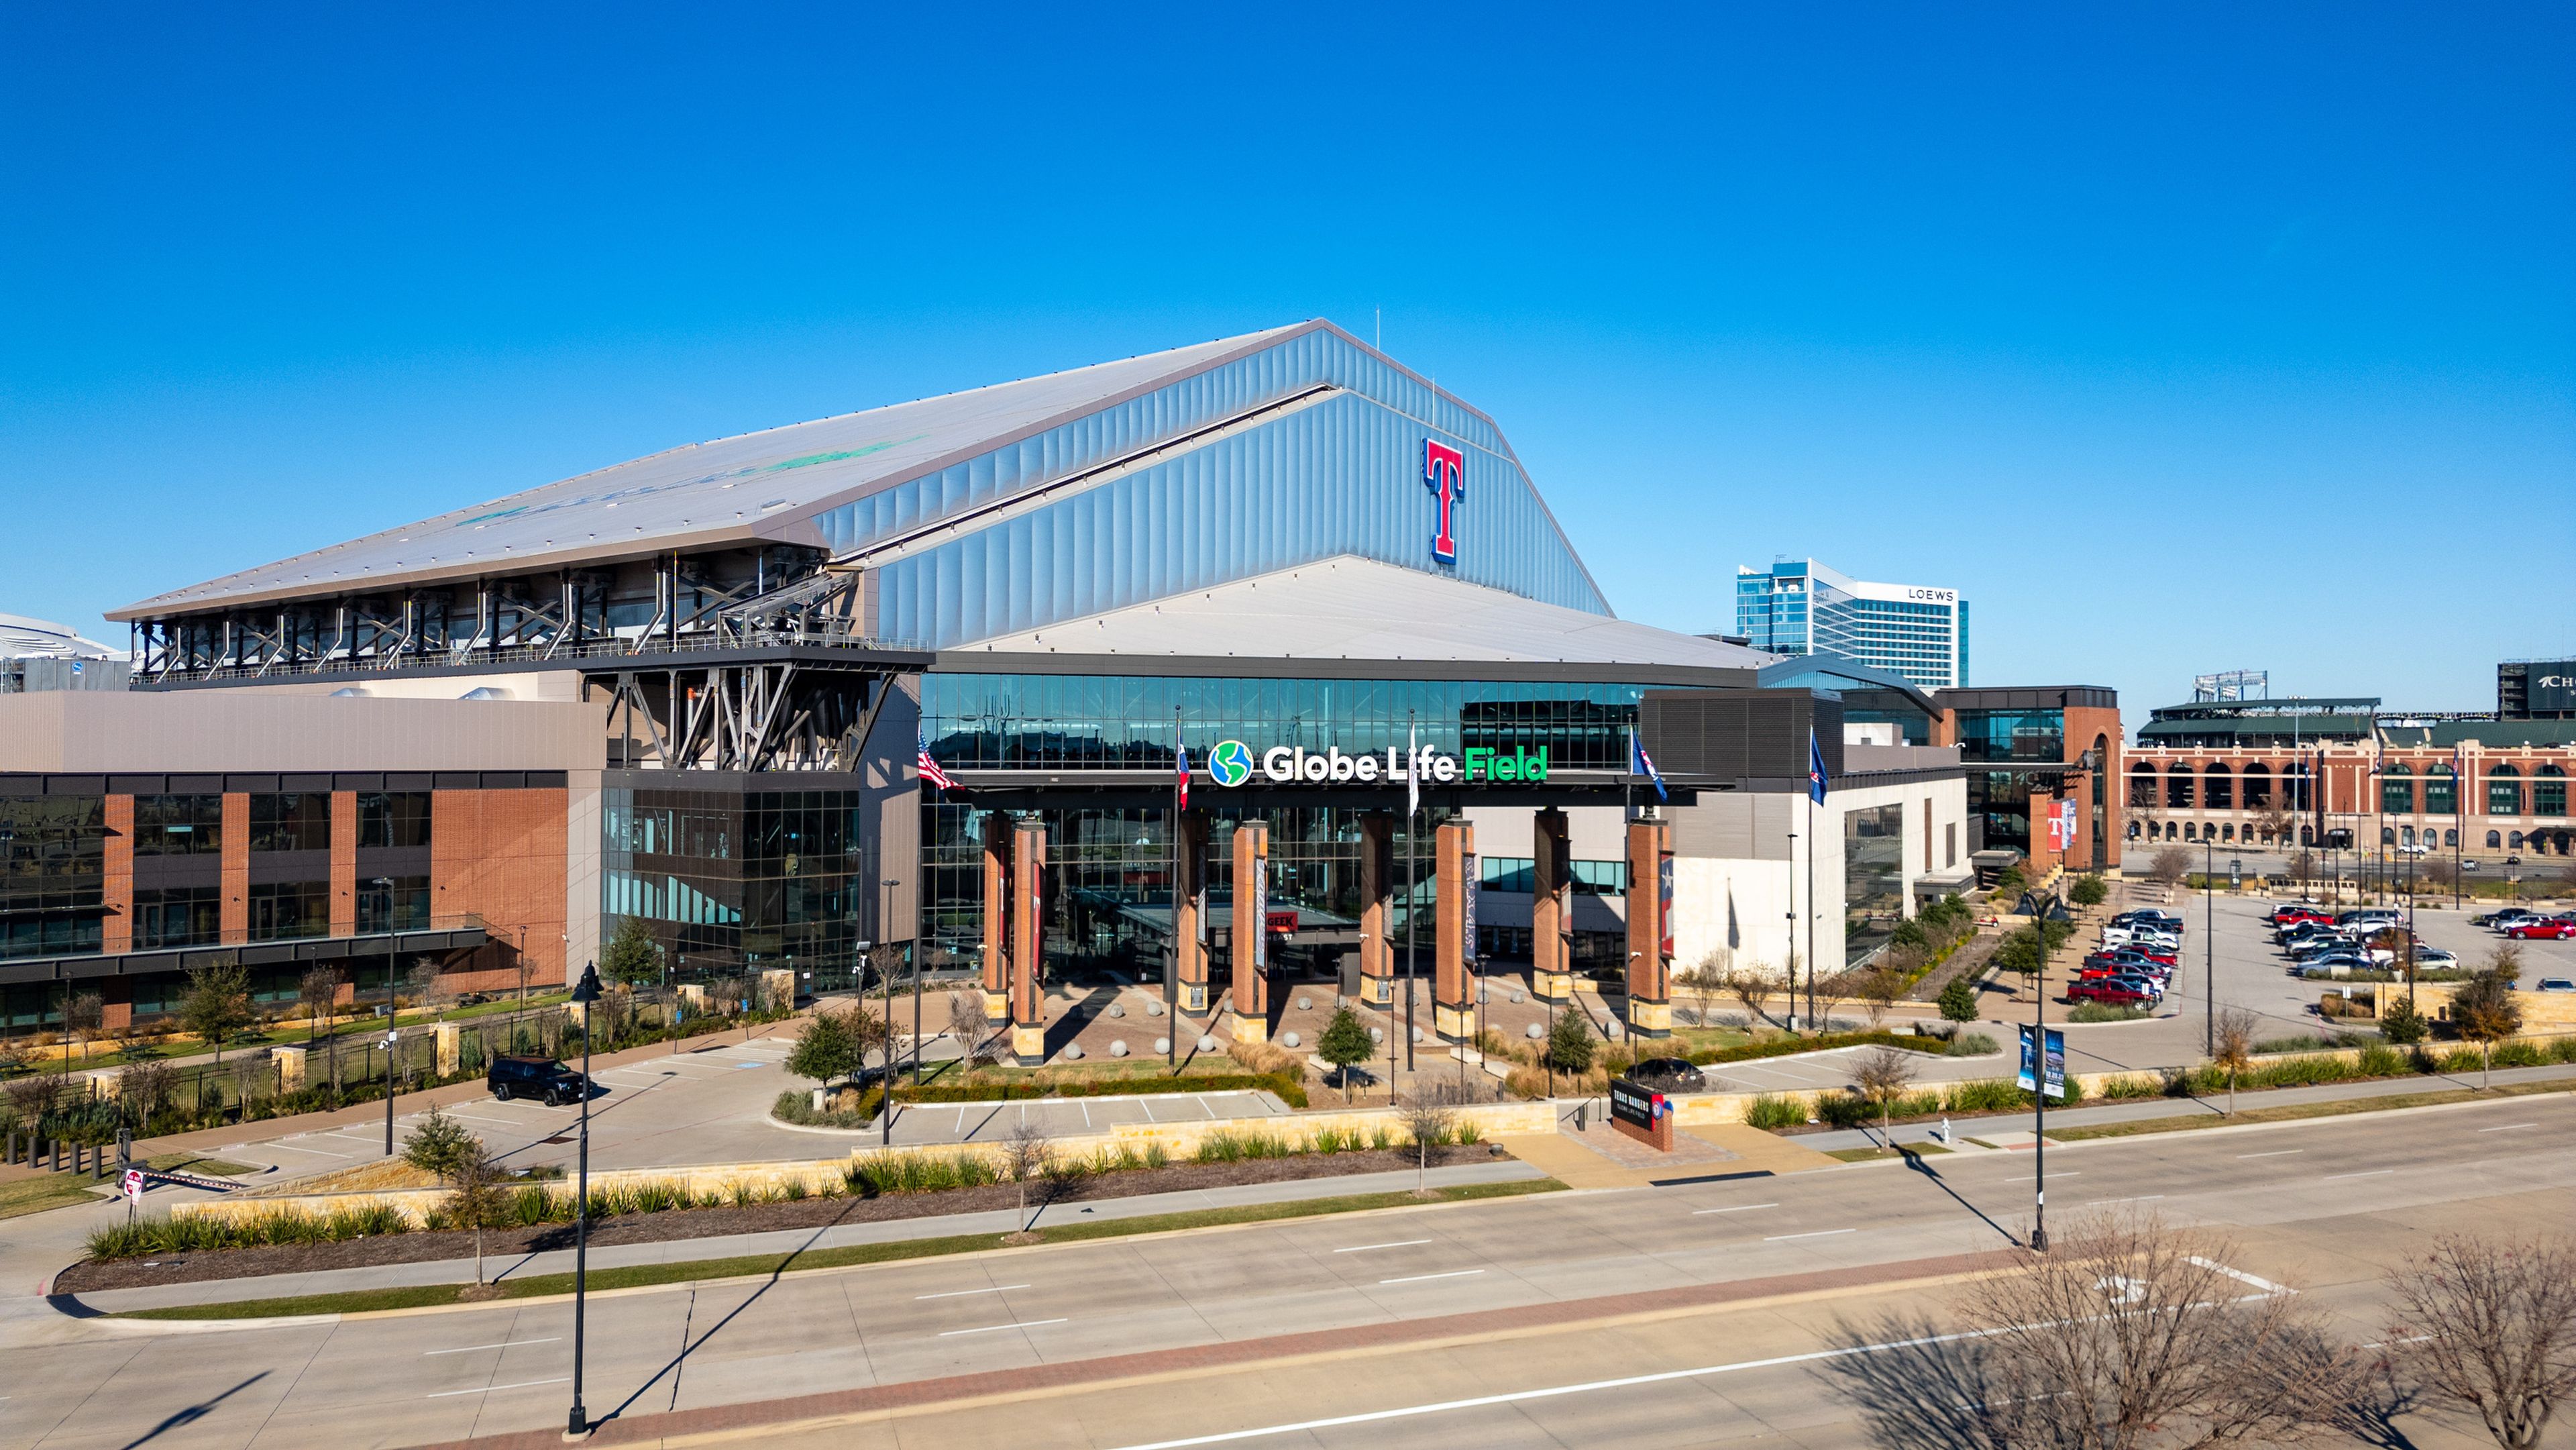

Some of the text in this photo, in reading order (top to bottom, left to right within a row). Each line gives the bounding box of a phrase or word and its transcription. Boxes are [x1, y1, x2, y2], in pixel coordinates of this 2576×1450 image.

[1424, 437, 1464, 565] T
[1909, 588, 1953, 601] LOEWS
[2548, 676, 2576, 687] CH
[1263, 745, 1379, 781] Globe
[1465, 745, 1547, 780] Field
